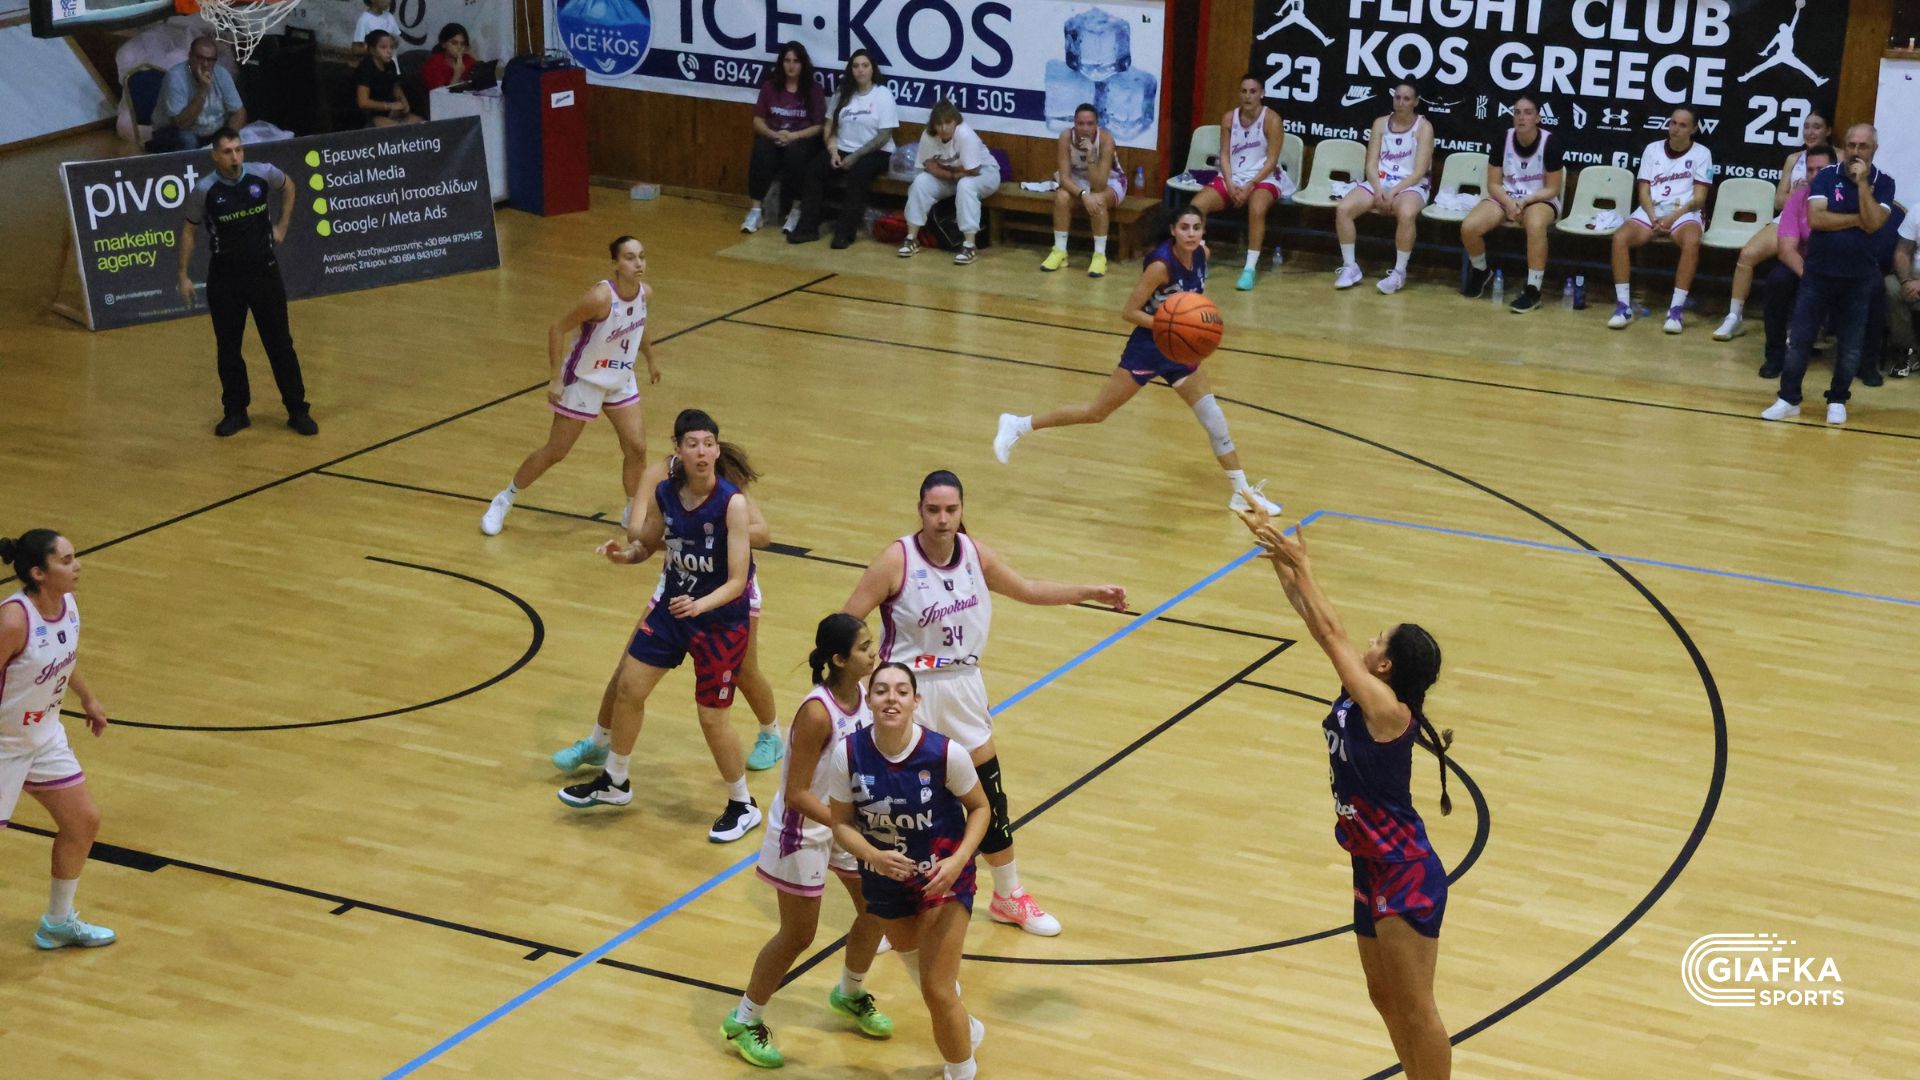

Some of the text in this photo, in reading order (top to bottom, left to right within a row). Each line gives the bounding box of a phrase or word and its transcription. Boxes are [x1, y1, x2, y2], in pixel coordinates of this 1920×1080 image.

[1571, 0, 1731, 47] CLUB
[1264, 52, 1321, 103] 23
[1345, 28, 1727, 107] KOS GREECE
[714, 60, 763, 85] 6947
[813, 71, 844, 94] 91
[933, 84, 967, 109] 141
[977, 88, 1016, 114] 505
[1347, 85, 1372, 98] NIKE
[1311, 122, 1358, 140] March
[1744, 95, 1812, 147] 23
[377, 137, 441, 157] Marketing
[1434, 137, 1482, 152] PLANET
[326, 165, 406, 188] Social Media
[1725, 165, 1754, 178] KOS
[84, 165, 199, 230] pivot
[329, 178, 478, 211] Κατασκευή Ιστοσελίδων
[1661, 185, 1672, 197] 3
[332, 215, 379, 234] Google
[389, 211, 421, 226] Meta
[424, 204, 448, 220] Ads
[94, 229, 176, 252] marketing
[424, 237, 437, 248] +30
[438, 235, 451, 246] 694
[97, 250, 157, 272] agency
[388, 254, 402, 265] +30
[402, 252, 416, 263] 694
[620, 338, 630, 354] 4
[942, 625, 963, 647] 34
[54, 675, 67, 694] 2
[894, 835, 908, 855] 5
